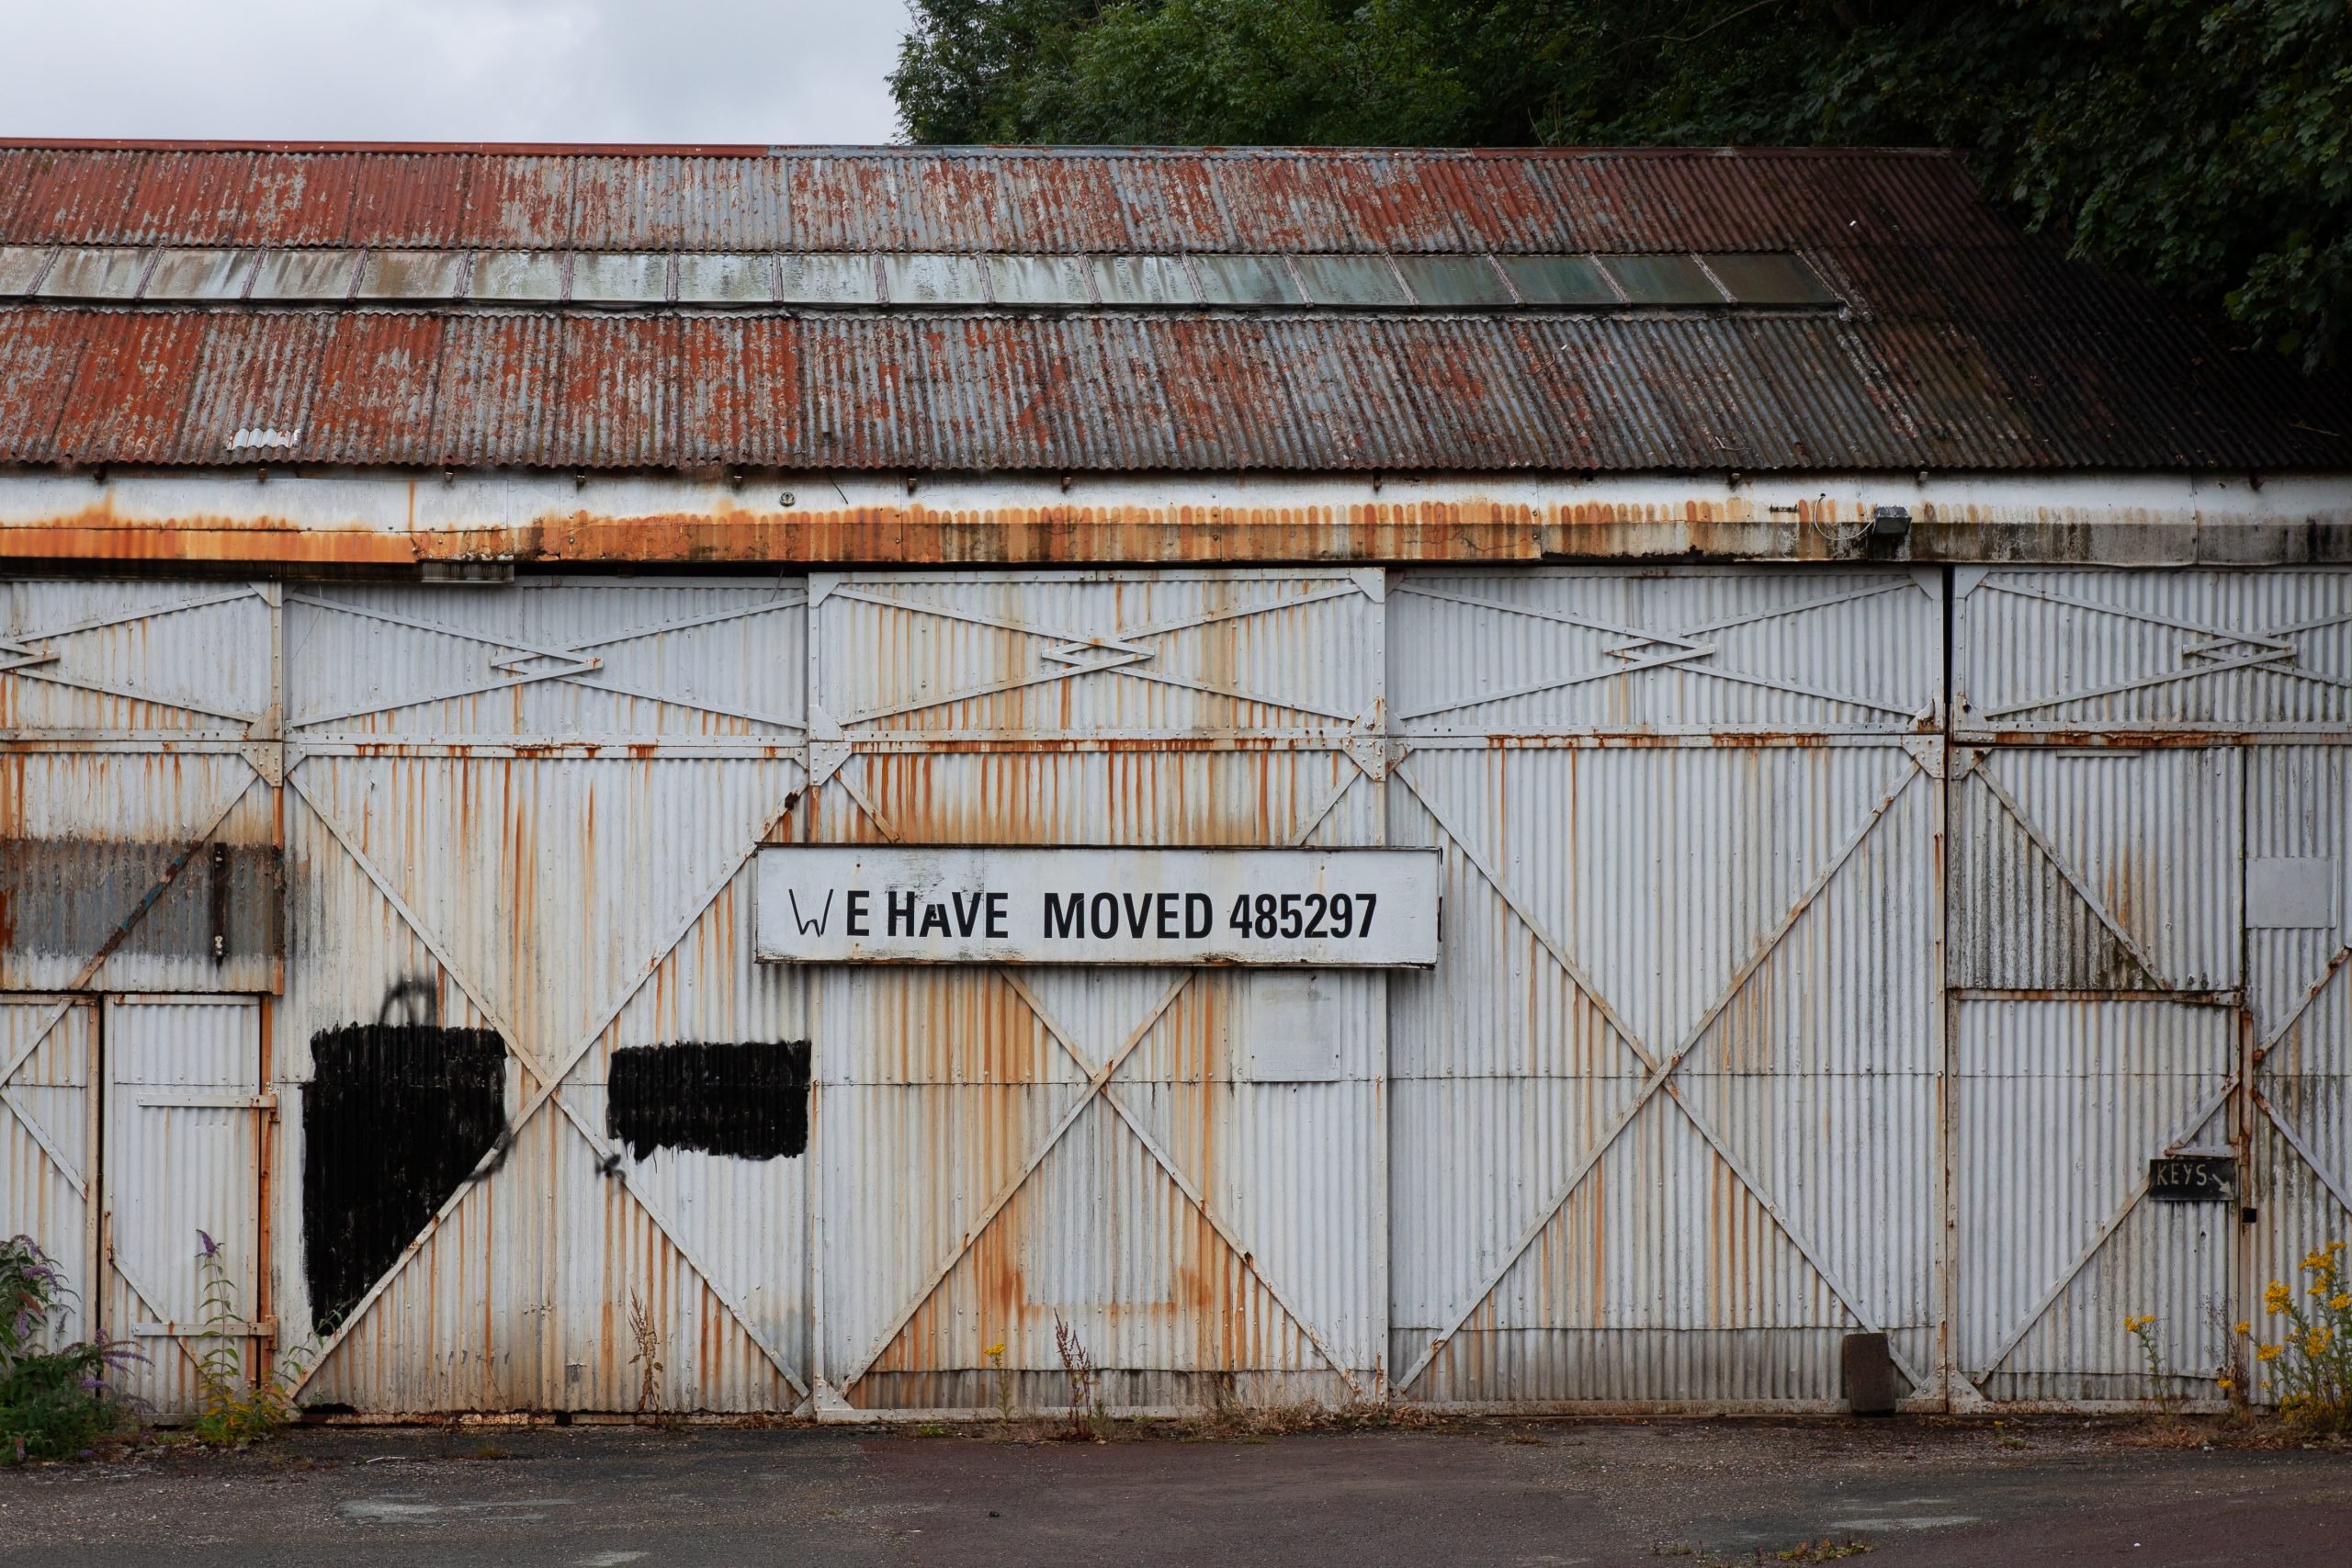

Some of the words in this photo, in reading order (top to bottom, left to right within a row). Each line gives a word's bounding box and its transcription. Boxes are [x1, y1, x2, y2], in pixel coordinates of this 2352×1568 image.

[788, 888, 870, 937] WE
[887, 890, 1009, 938] HAVE
[1043, 892, 1213, 939] MOVED
[1229, 893, 1377, 939] 485297
[2156, 1162, 2207, 1186] KEYS
